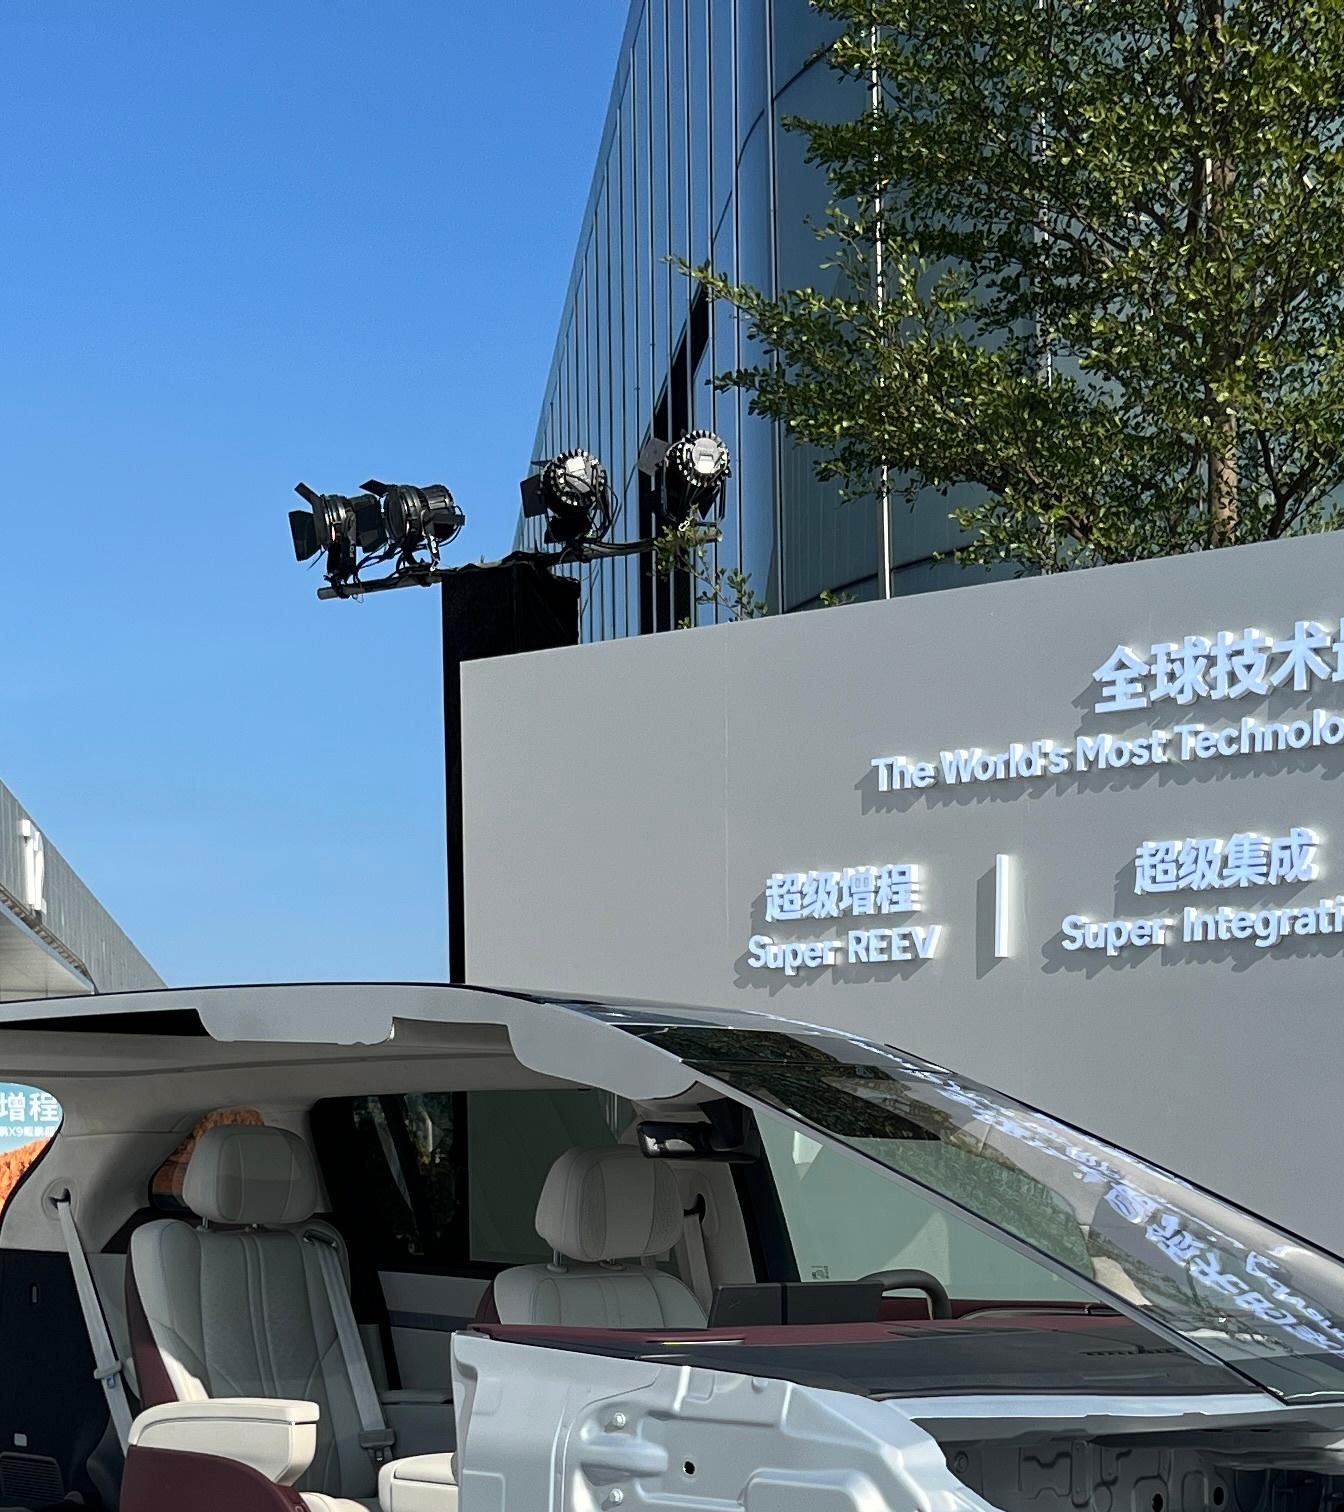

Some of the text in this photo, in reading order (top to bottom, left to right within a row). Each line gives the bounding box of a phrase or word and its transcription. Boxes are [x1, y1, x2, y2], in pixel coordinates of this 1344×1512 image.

[871, 756, 937, 791] The
[940, 740, 1071, 784] World's
[1076, 730, 1169, 771] Most
[1134, 827, 1320, 895] 超级集成
[765, 864, 921, 922] 超级增程
[748, 925, 942, 975] Super REEV
[1061, 915, 1173, 956] Super
